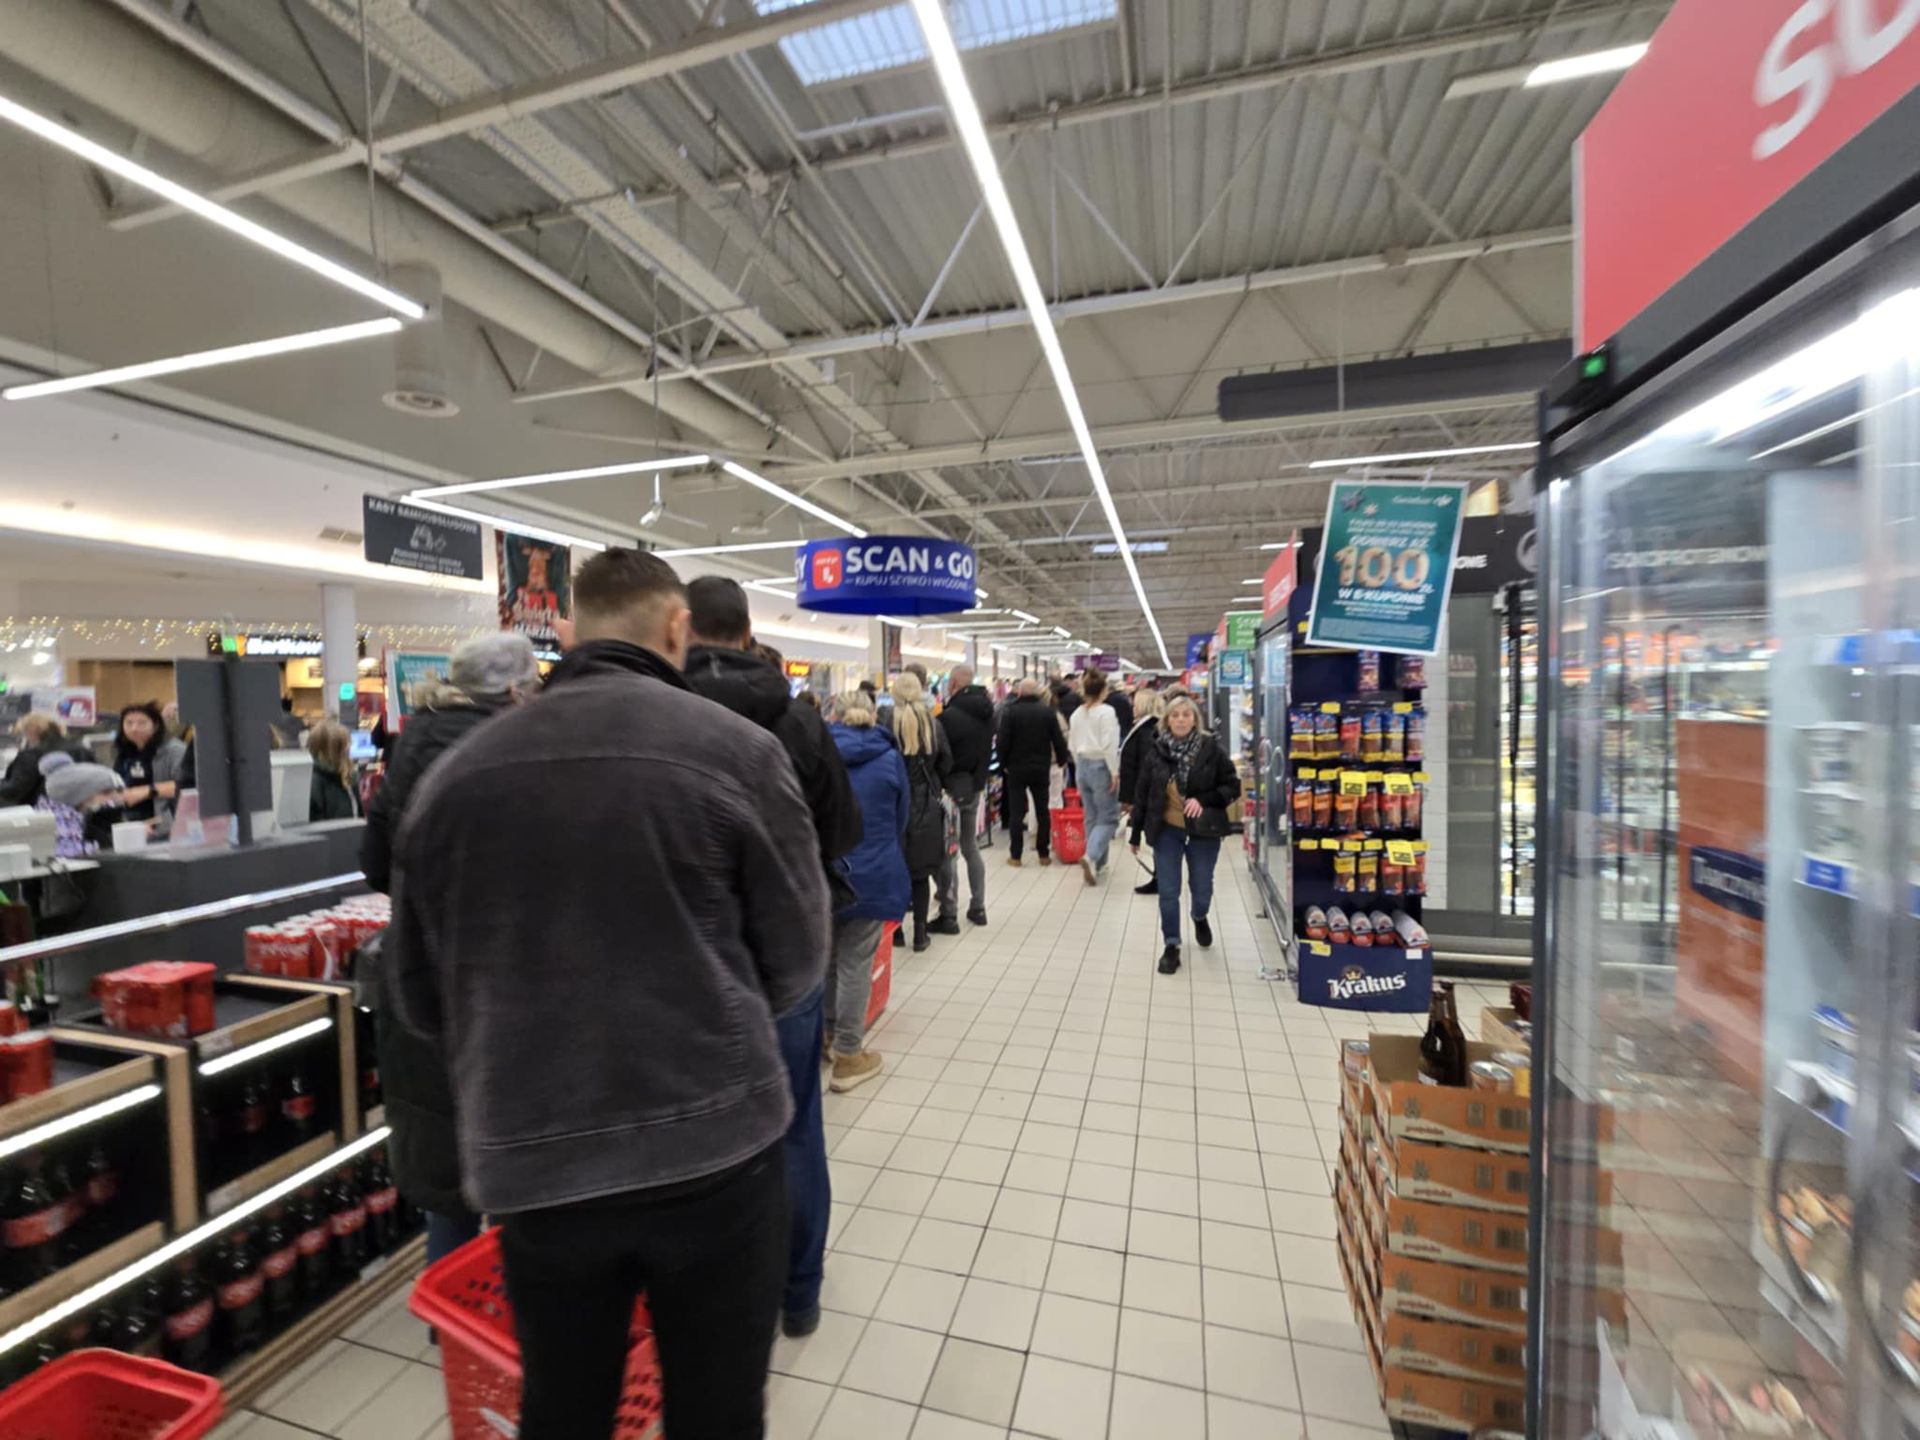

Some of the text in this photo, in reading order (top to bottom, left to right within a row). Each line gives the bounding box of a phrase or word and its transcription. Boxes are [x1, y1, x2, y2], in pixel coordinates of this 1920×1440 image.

[846, 545, 973, 579] SCAN & GO
[1334, 546, 1429, 590] 100
[1327, 974, 1406, 999] Krakus
